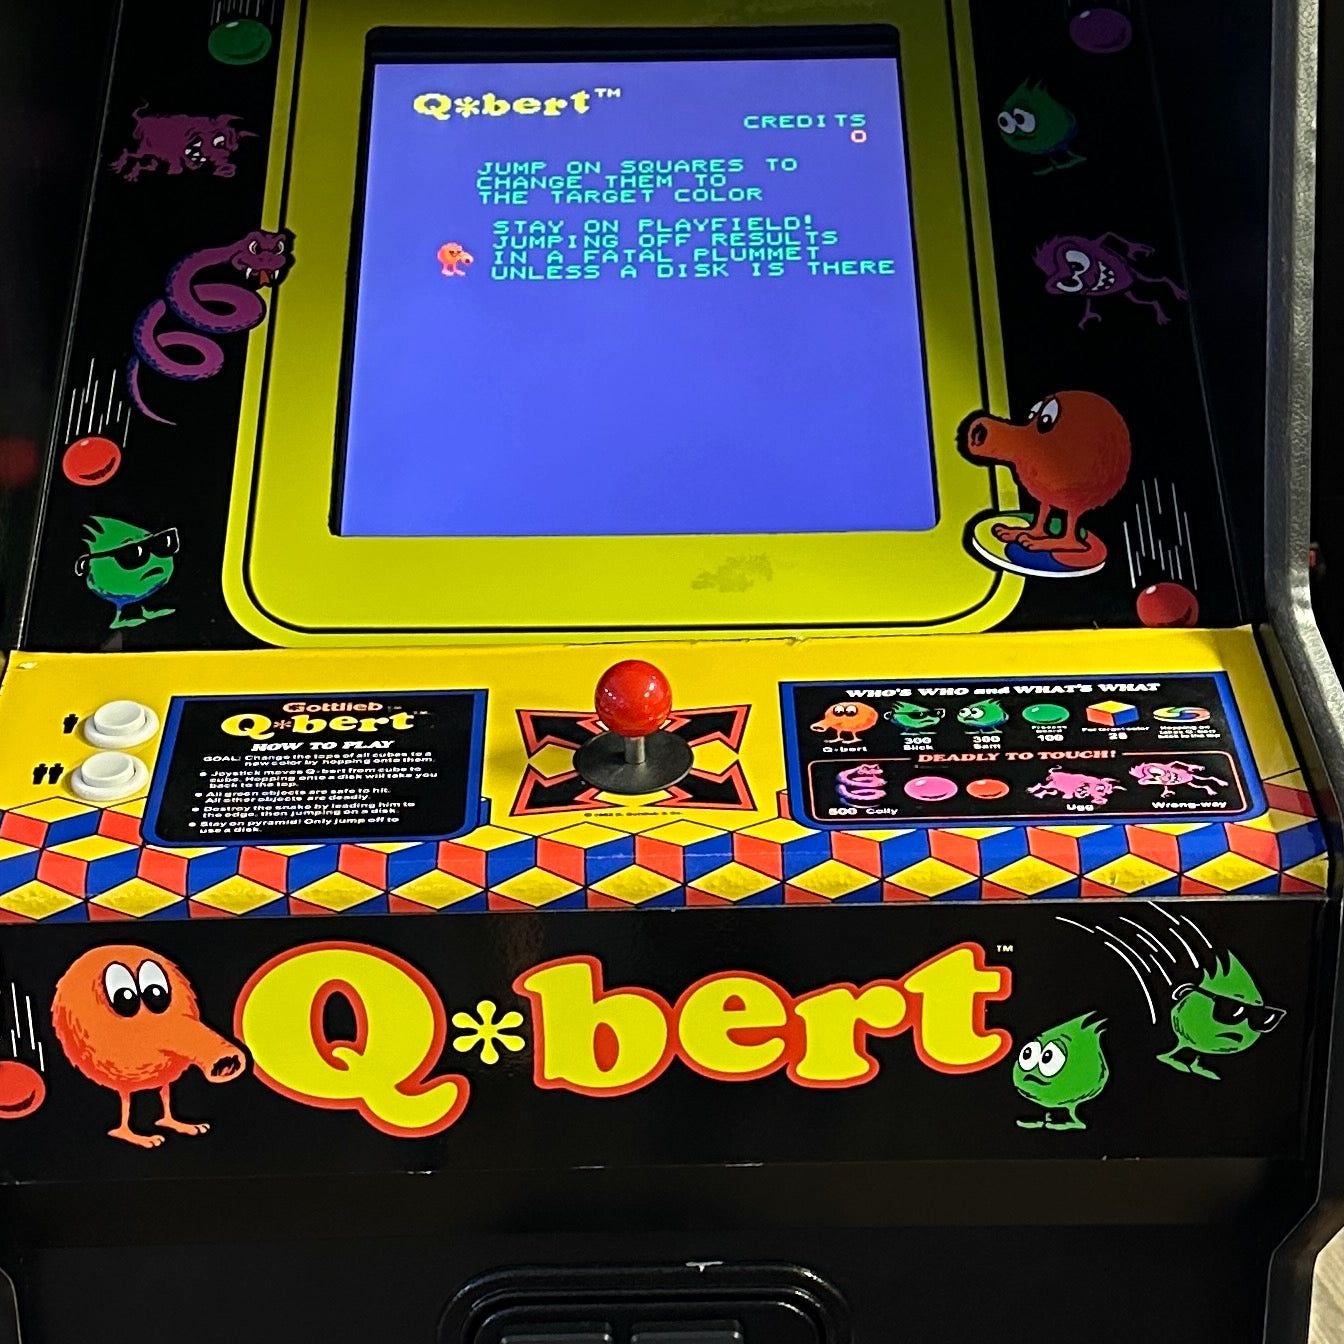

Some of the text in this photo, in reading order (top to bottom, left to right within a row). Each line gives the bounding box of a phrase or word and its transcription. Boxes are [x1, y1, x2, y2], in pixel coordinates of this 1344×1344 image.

[743, 114, 866, 129] CREDITS
[477, 158, 798, 175] JUMP ON SQUARES TO
[476, 174, 727, 190] CHANGE THEM TO
[479, 188, 763, 205] THE TARGET COLOR
[493, 214, 812, 234] STAY ON PLAYFIELD!
[492, 231, 838, 249] JUMPING OFF RESULTS
[494, 247, 819, 264] IN A FATAL PLUMMET
[491, 260, 895, 280] UNLESS A DISK IS THERE
[846, 683, 1161, 698] WHO'S WHO and WHAT'S WHAT
[283, 702, 383, 713] Gottlieb
[905, 737, 932, 745] 300
[1037, 734, 1064, 742] 100
[251, 740, 396, 752] HOW TO PLAY
[917, 750, 1116, 763] DEADLY TO TOUCH!
[1152, 801, 1227, 809] Wrong-way
